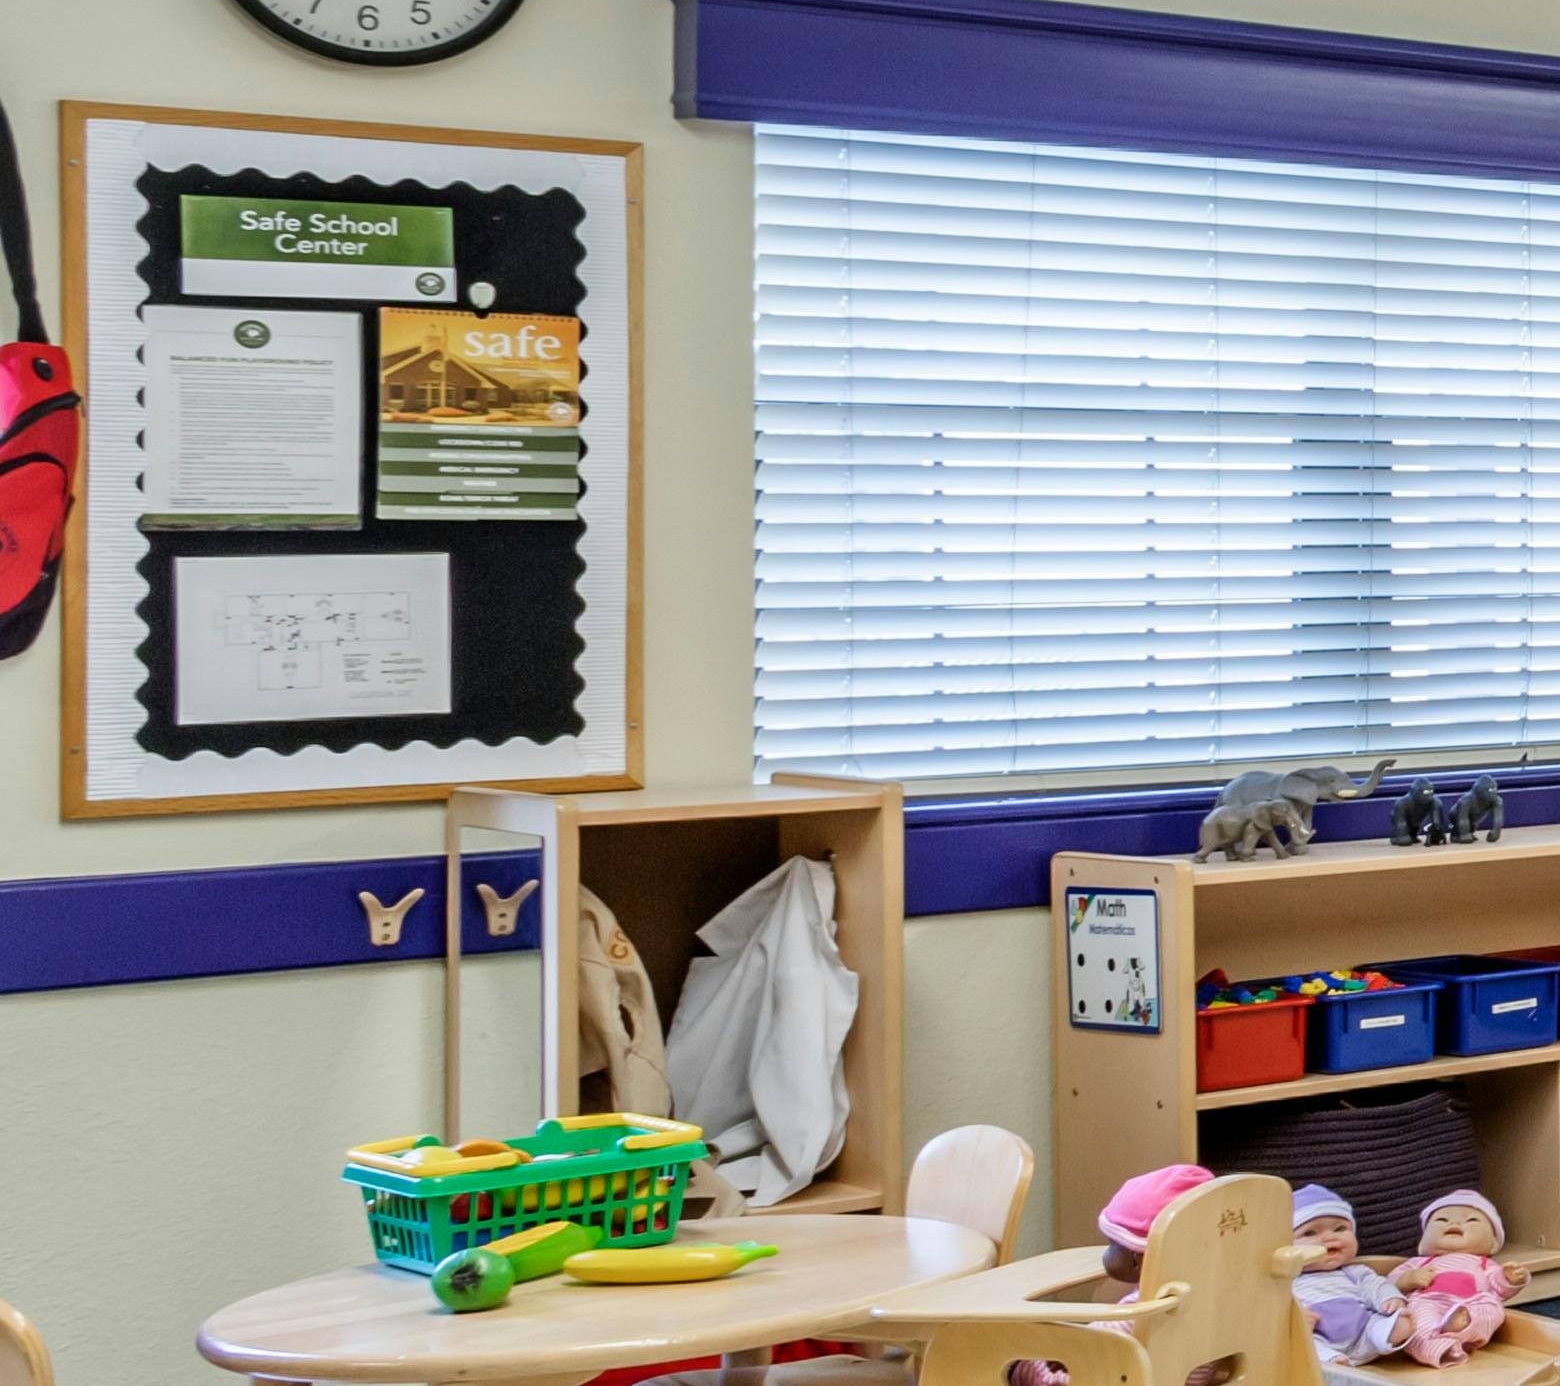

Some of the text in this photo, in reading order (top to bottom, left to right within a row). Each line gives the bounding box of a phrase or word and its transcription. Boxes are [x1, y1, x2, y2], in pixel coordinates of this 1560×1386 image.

[356, 6, 379, 30] 6
[410, 0, 432, 25] 5
[240, 210, 398, 237] Safe School
[275, 234, 368, 256] Center
[464, 325, 561, 360] safe
[1096, 898, 1127, 917] Math
